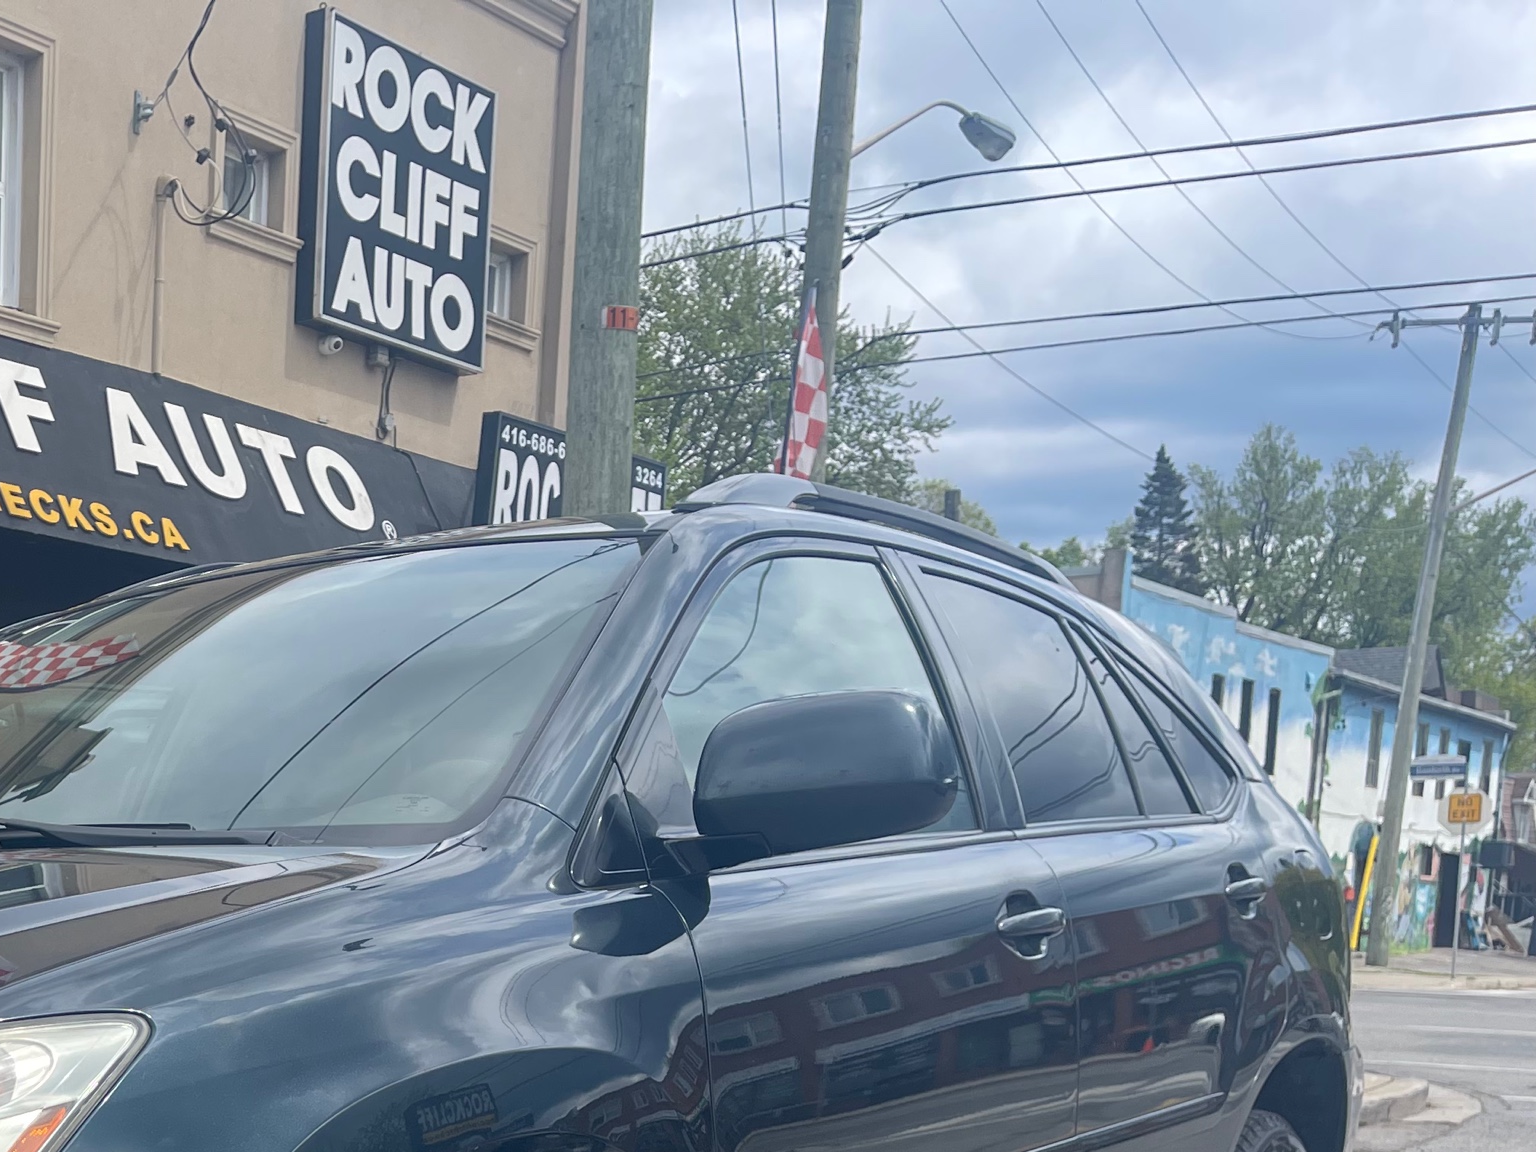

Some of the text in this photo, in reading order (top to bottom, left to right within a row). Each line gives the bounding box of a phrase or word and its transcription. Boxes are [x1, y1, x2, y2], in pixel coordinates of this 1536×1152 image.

[331, 20, 491, 174] ROCK
[335, 135, 480, 260] CLIFF
[331, 236, 475, 352] AUTO
[105, 387, 376, 531] AUTO
[501, 424, 566, 459] 416-686-6
[1457, 798, 1473, 807] NO
